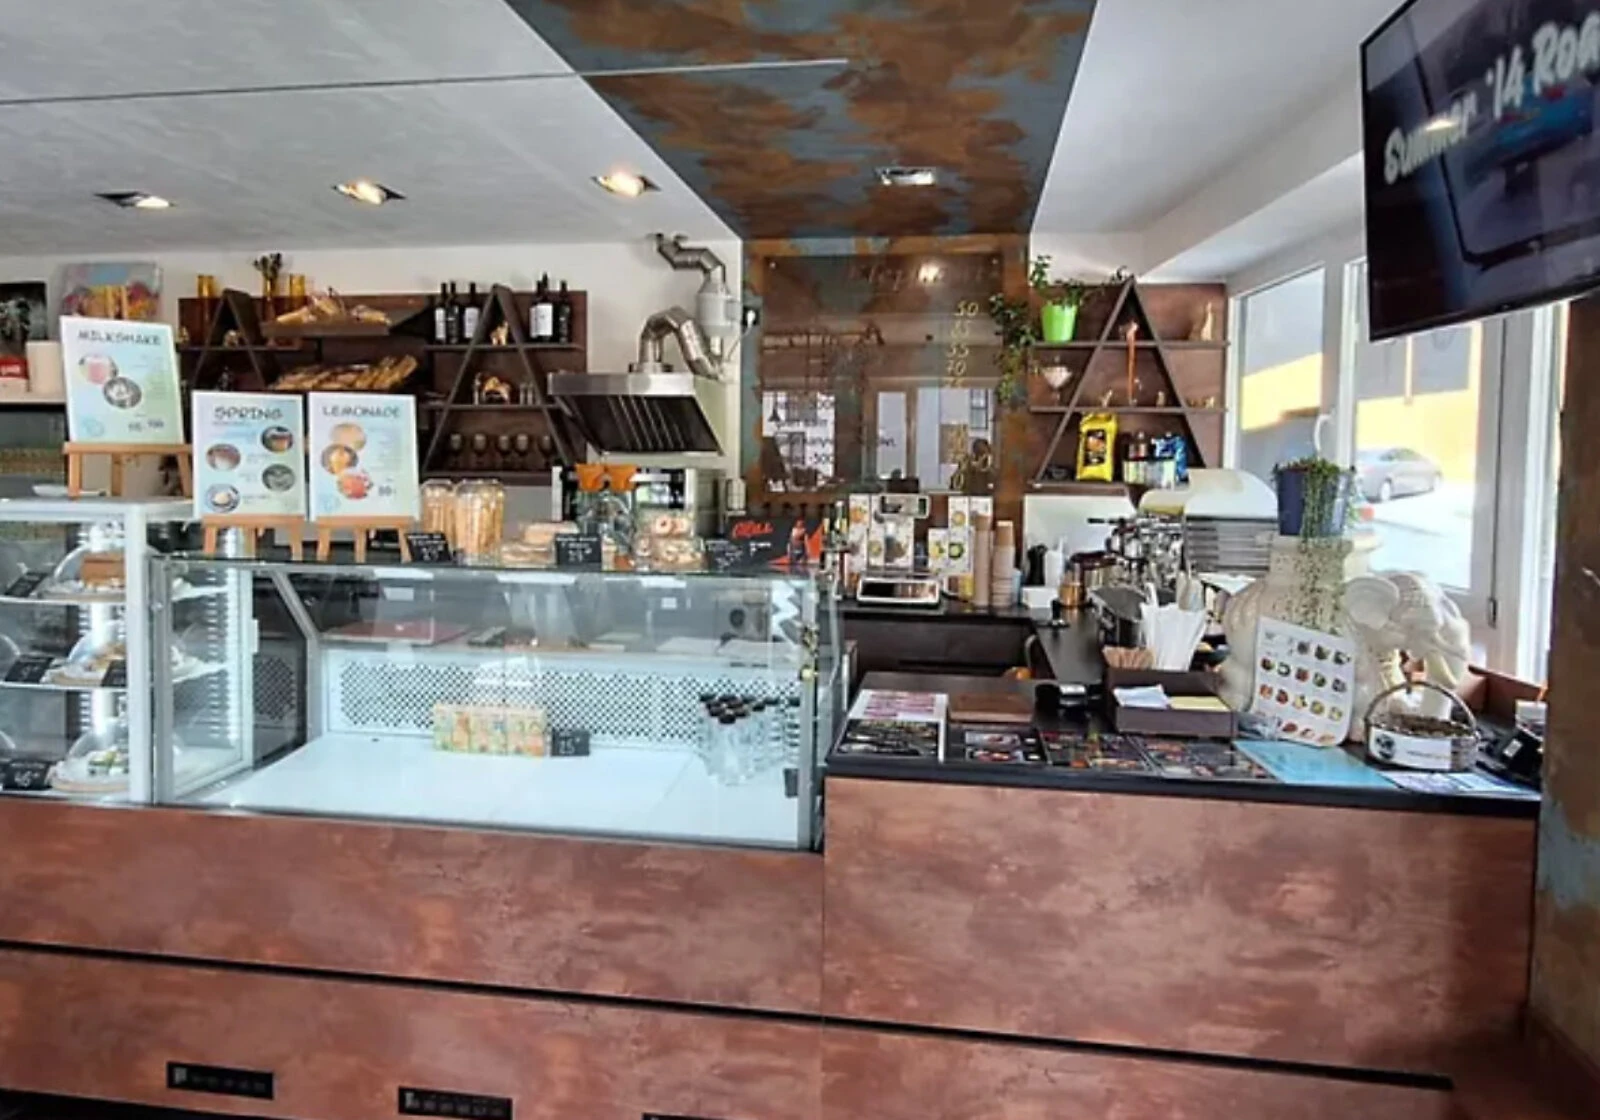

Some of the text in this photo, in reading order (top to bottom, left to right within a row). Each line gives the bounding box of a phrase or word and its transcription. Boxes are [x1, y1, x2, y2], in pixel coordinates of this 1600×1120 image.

[77, 329, 162, 347] MILKSHAKE
[213, 405, 284, 421] SPRING
[321, 405, 402, 418] LEMONADE
